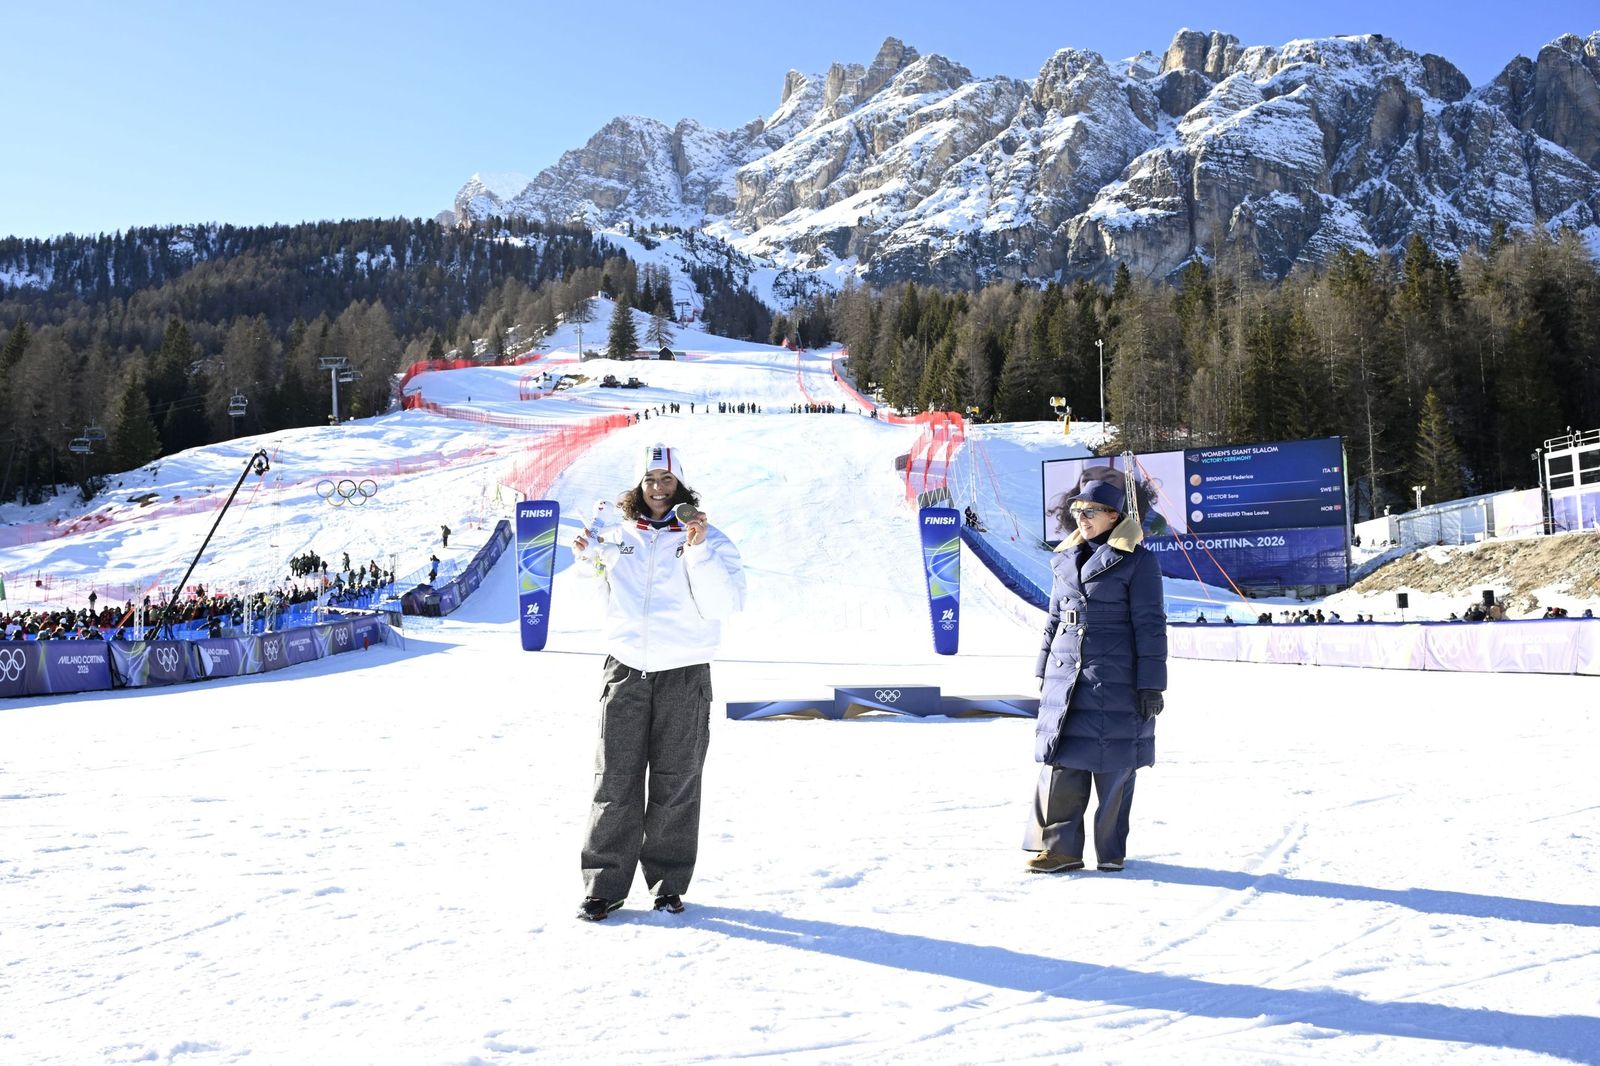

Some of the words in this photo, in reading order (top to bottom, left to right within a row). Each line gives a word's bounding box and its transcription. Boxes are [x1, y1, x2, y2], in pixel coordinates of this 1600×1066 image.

[1201, 450, 1231, 458] WOMEN'S
[1232, 448, 1252, 456] GIANT
[1253, 446, 1279, 454] SLALOM
[520, 509, 553, 518] FINISH
[924, 517, 956, 525] FINISH
[1196, 538, 1254, 550] CORTINA
[1257, 536, 1286, 547] 2026
[58, 655, 82, 664] MILANO
[82, 655, 106, 664] CORTINA
